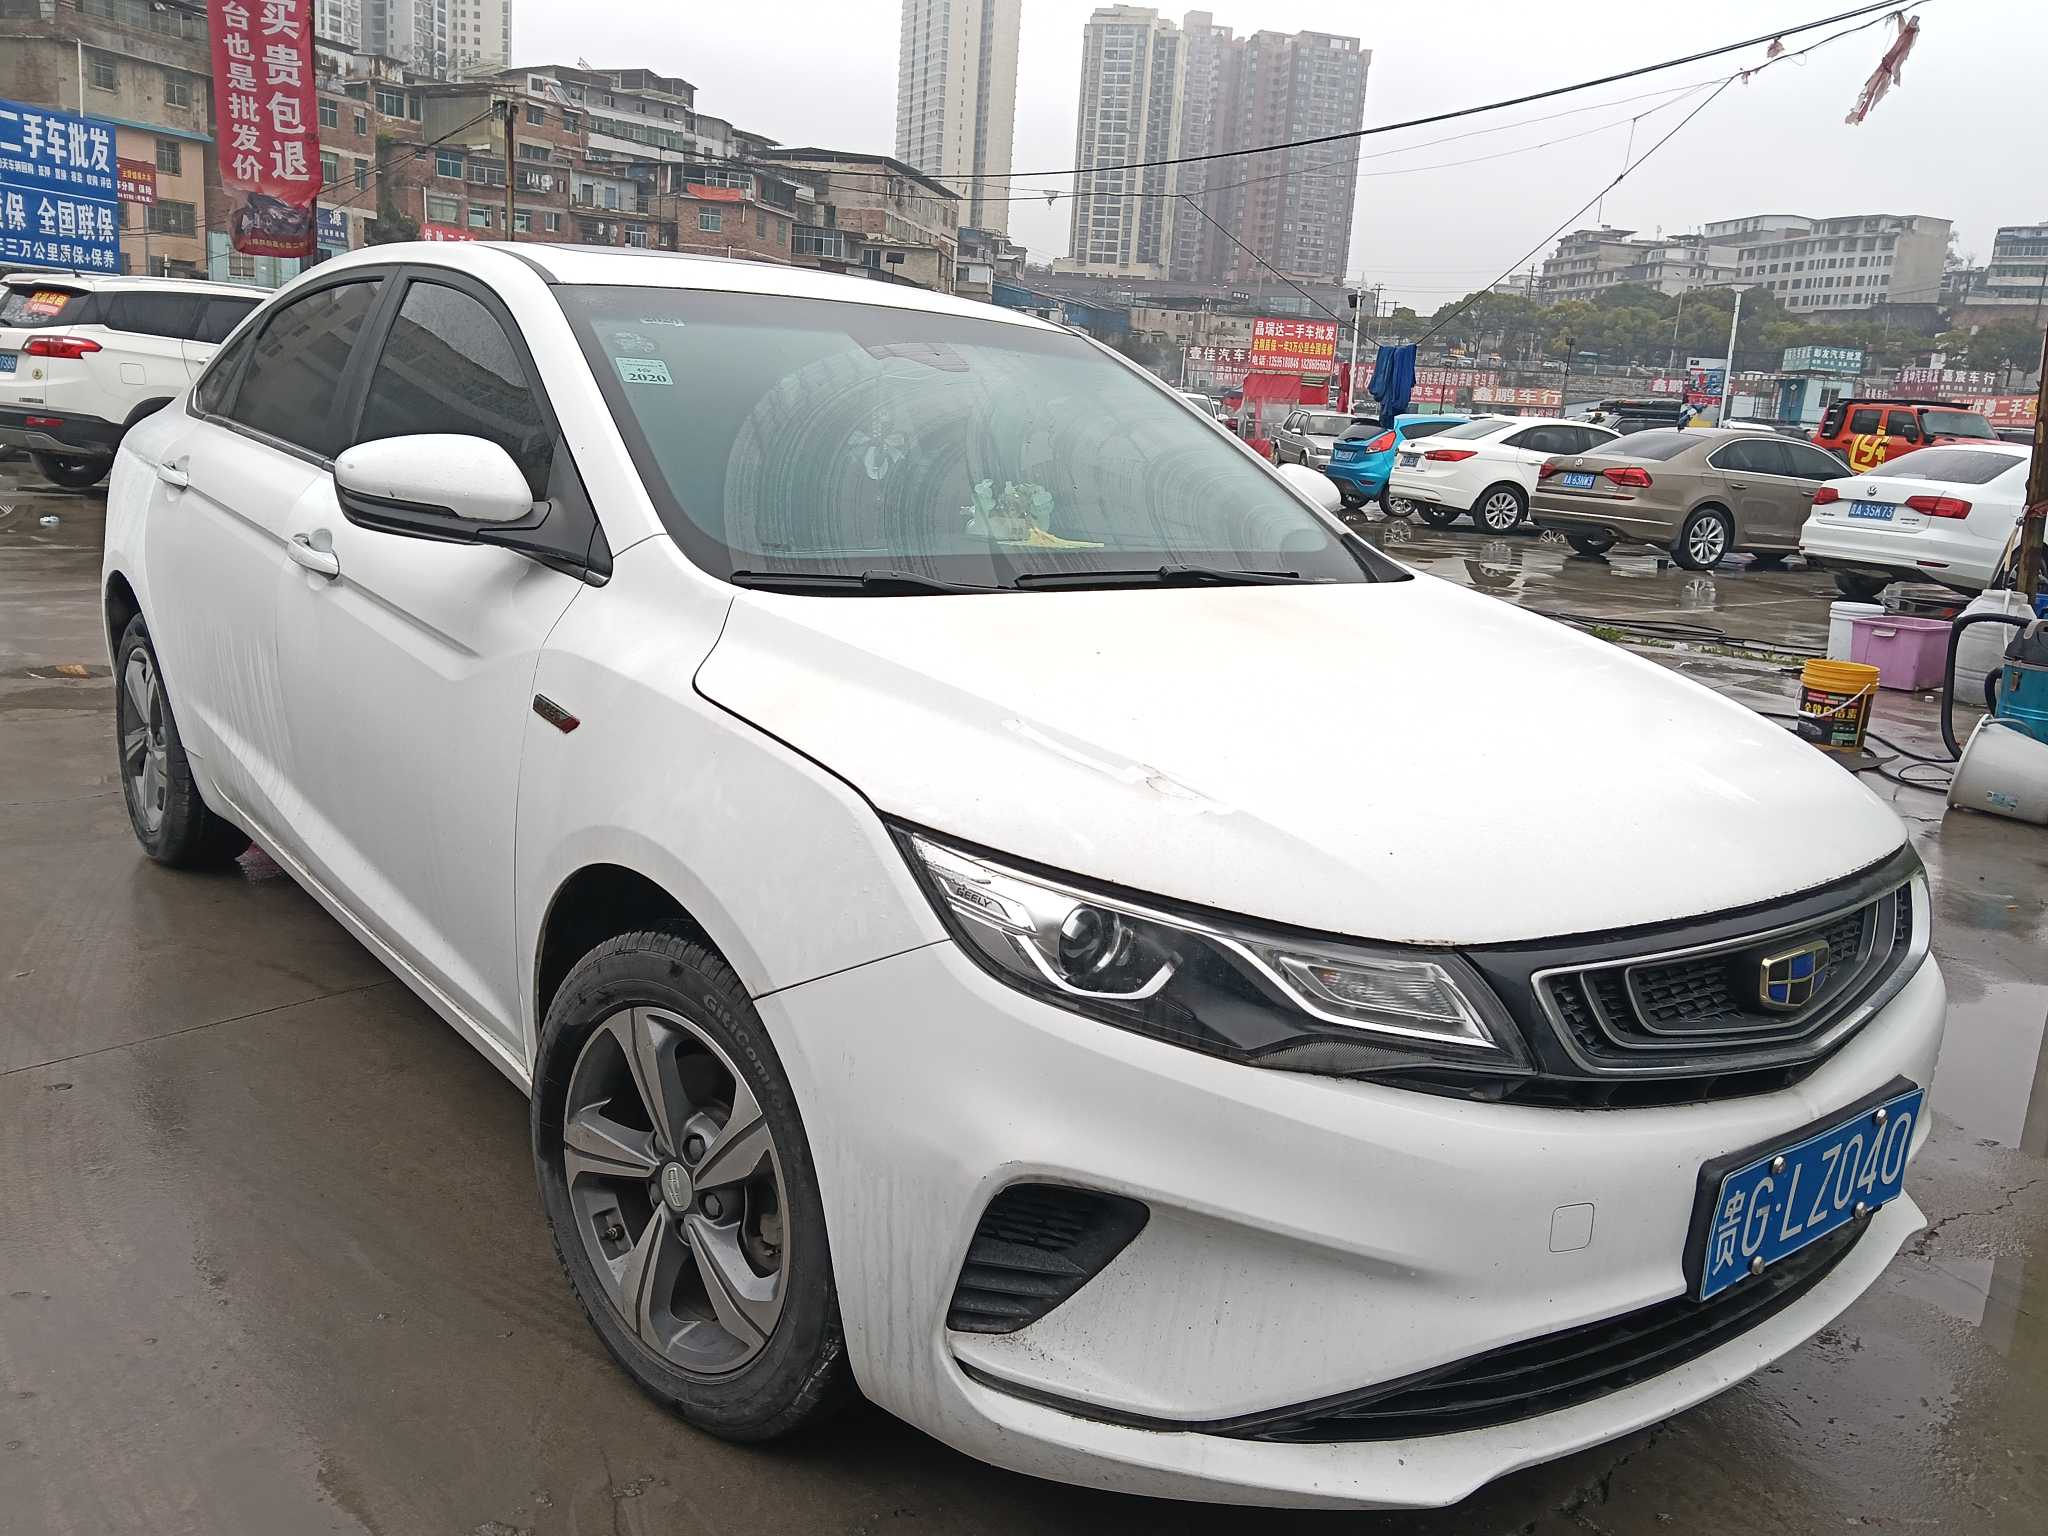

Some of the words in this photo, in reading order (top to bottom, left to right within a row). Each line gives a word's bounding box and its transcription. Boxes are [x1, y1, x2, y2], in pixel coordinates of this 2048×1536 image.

[222, 1, 262, 183] 台也是批发价
[0, 109, 110, 174] 二手车批发
[37, 196, 114, 243] 全国联保
[628, 373, 667, 383] 2020
[956, 886, 992, 908] GEELY
